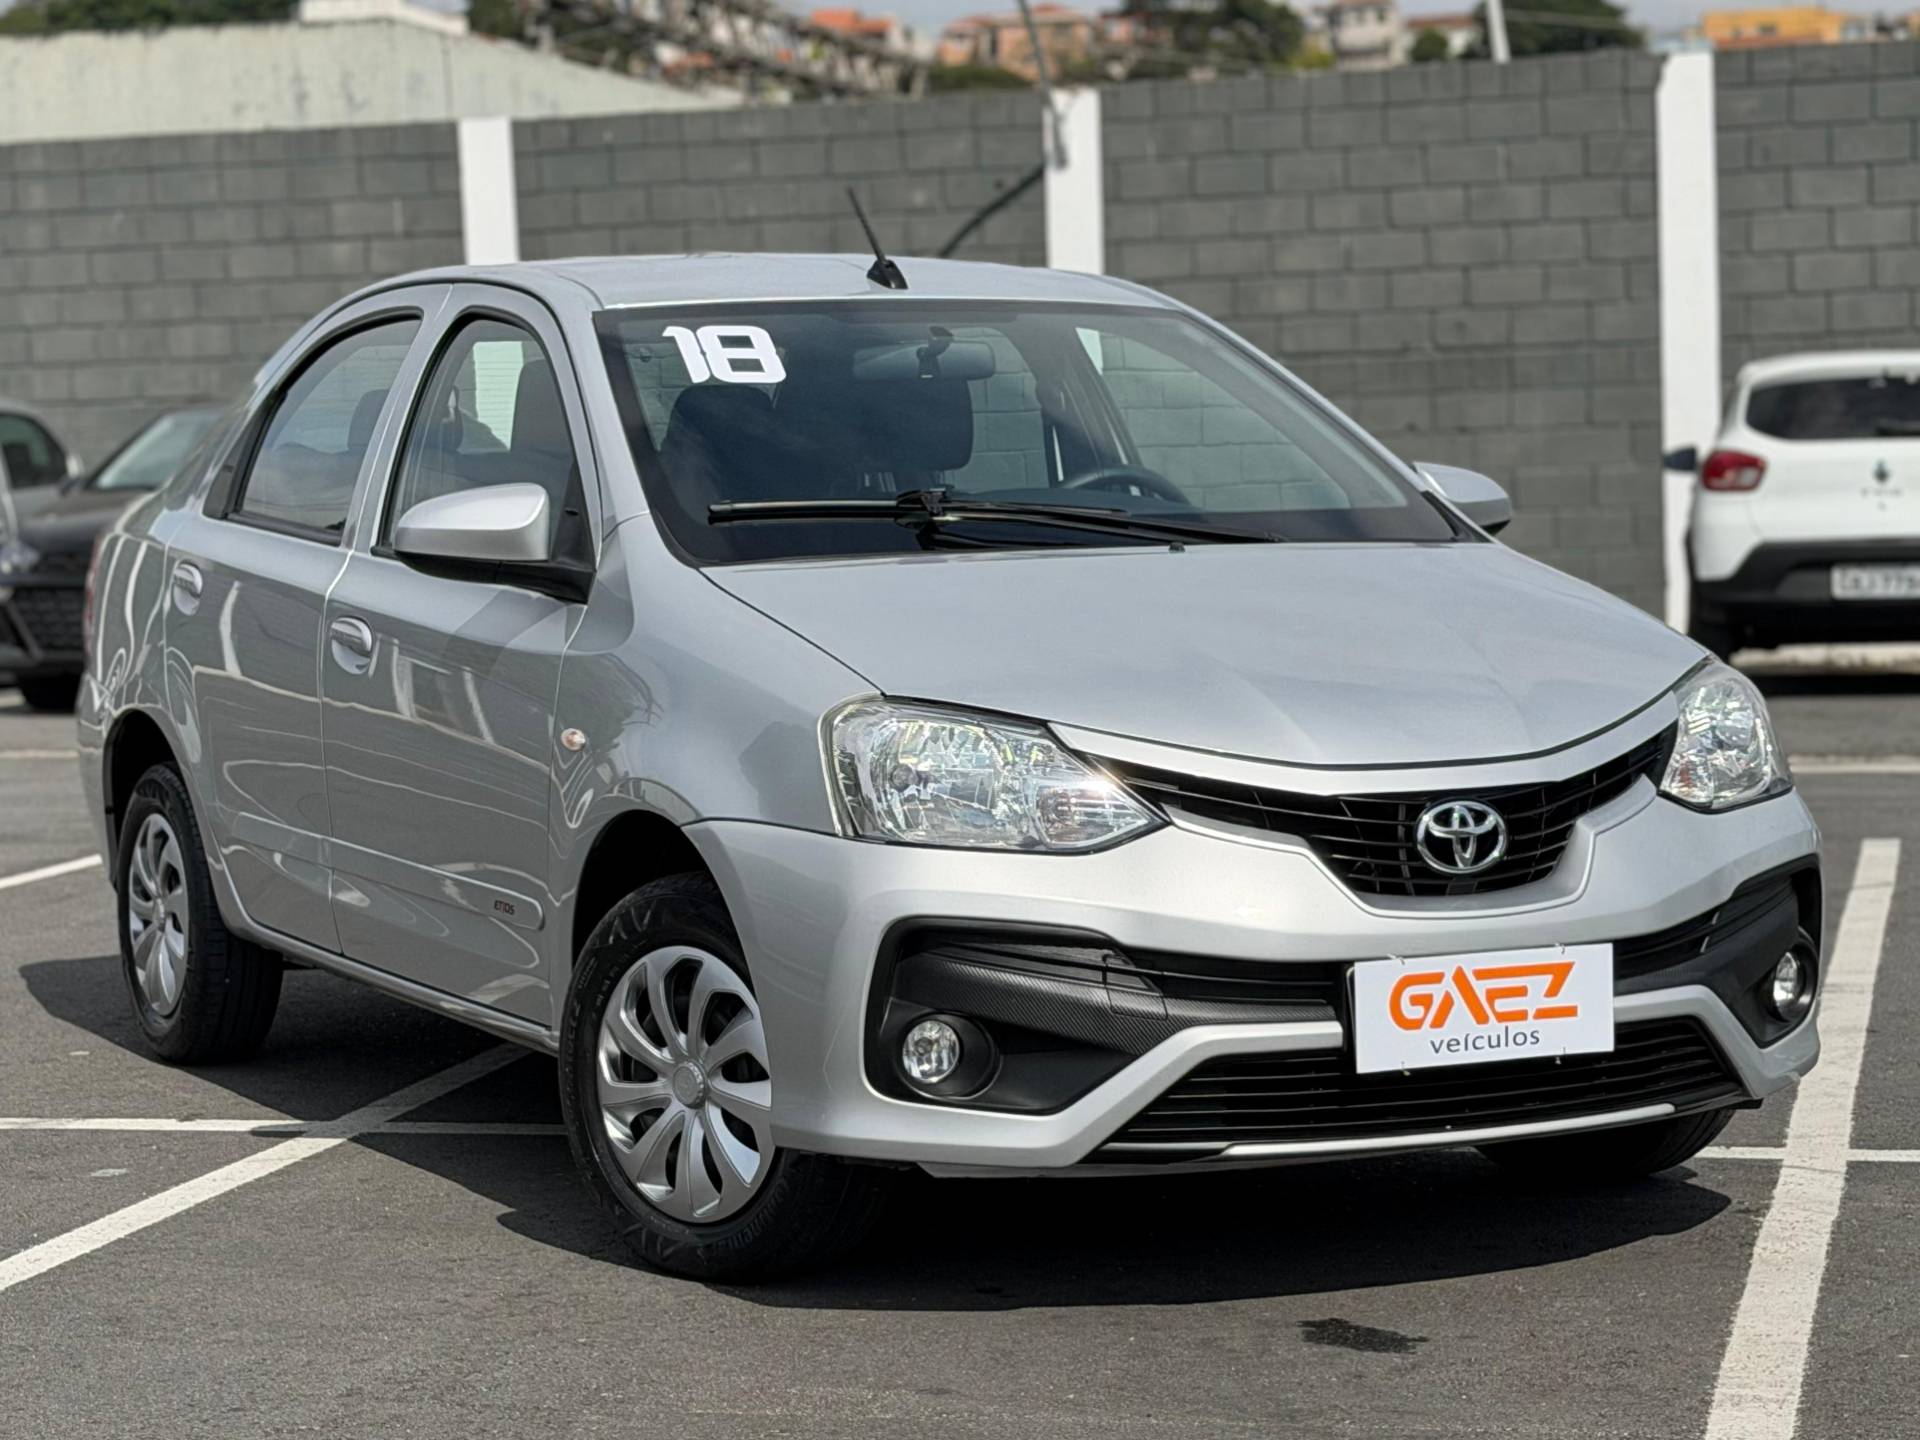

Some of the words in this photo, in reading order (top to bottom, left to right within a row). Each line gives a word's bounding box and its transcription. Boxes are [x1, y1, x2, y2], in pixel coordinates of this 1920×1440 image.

[662, 325, 787, 384] 18
[1388, 961, 1578, 1031] GAEZ
[1430, 1025, 1541, 1054] veículos
